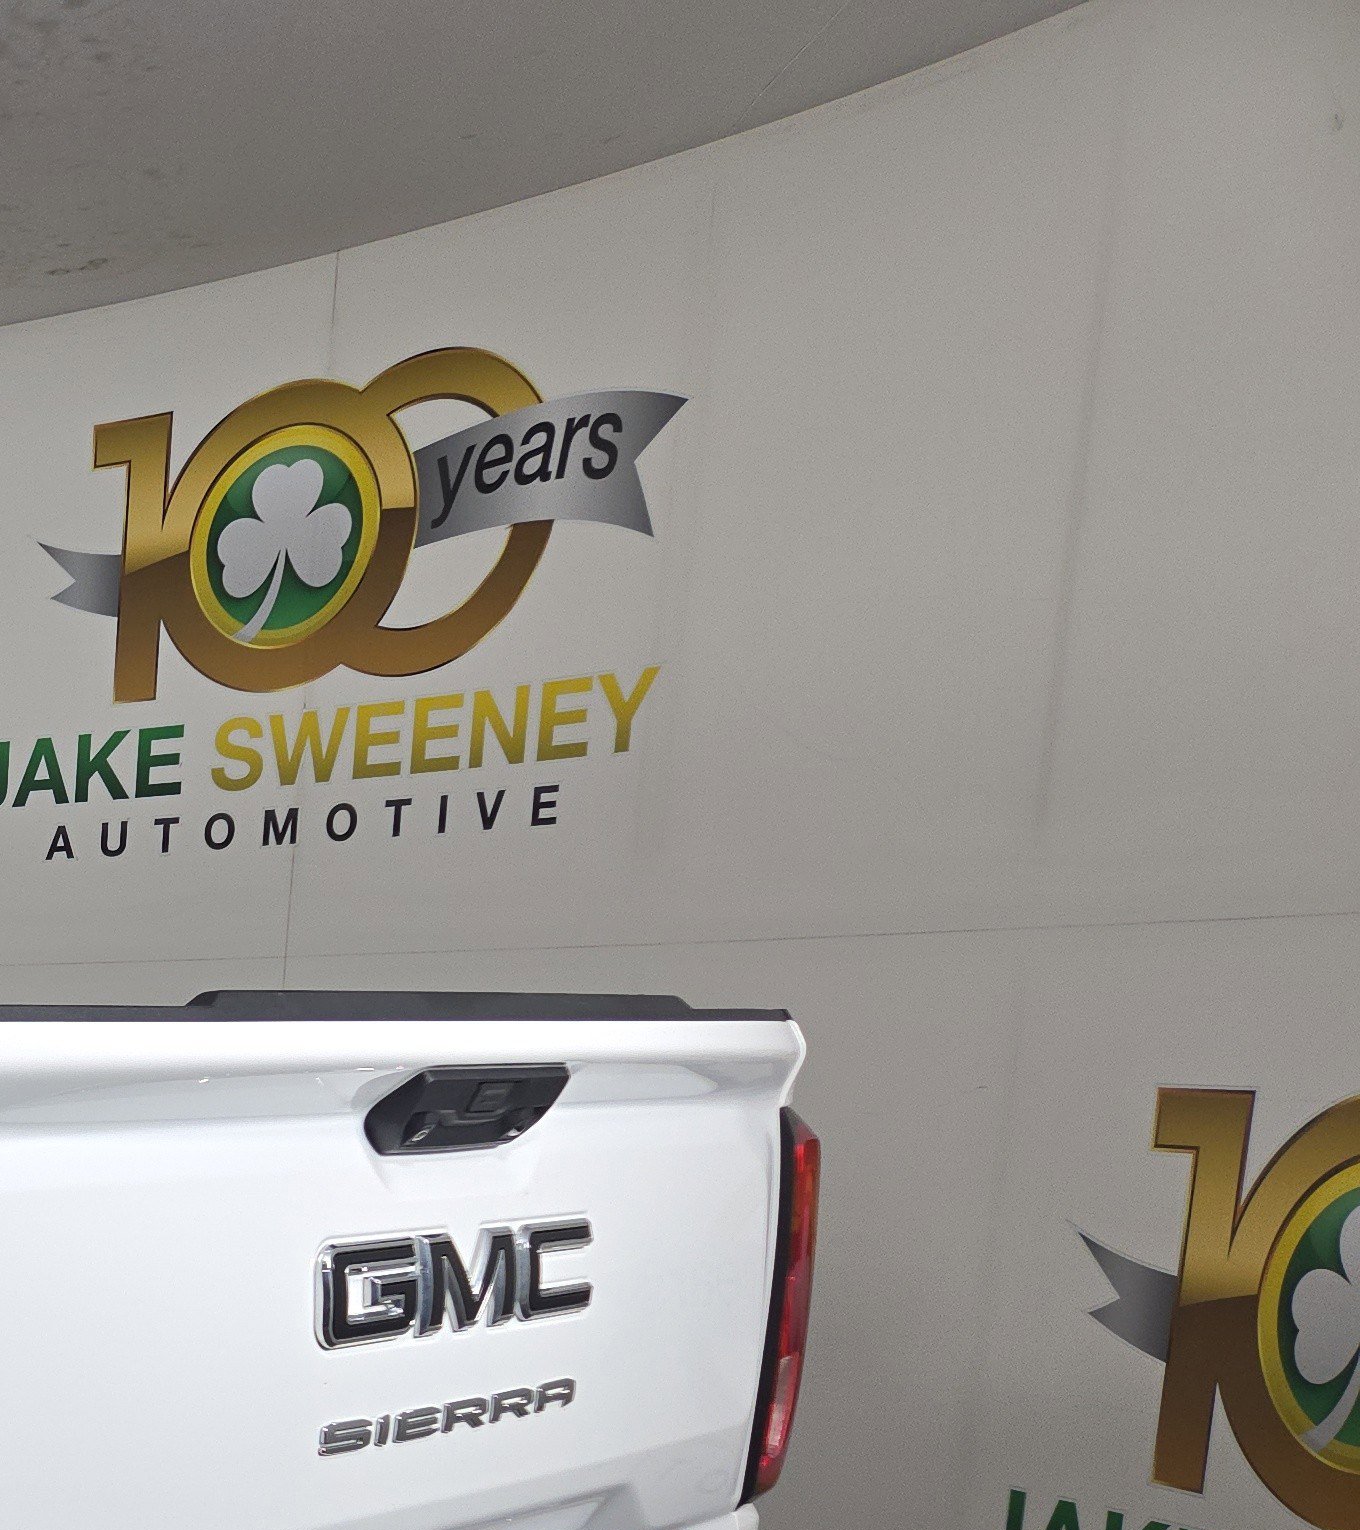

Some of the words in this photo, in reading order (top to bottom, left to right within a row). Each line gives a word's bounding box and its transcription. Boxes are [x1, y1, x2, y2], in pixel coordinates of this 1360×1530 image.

[432, 409, 624, 530] years
[210, 666, 661, 792] SWEENEY
[46, 784, 560, 861] AUTOMOTIVE
[314, 1217, 594, 1351] GMC
[317, 1377, 577, 1456] SIERRA
